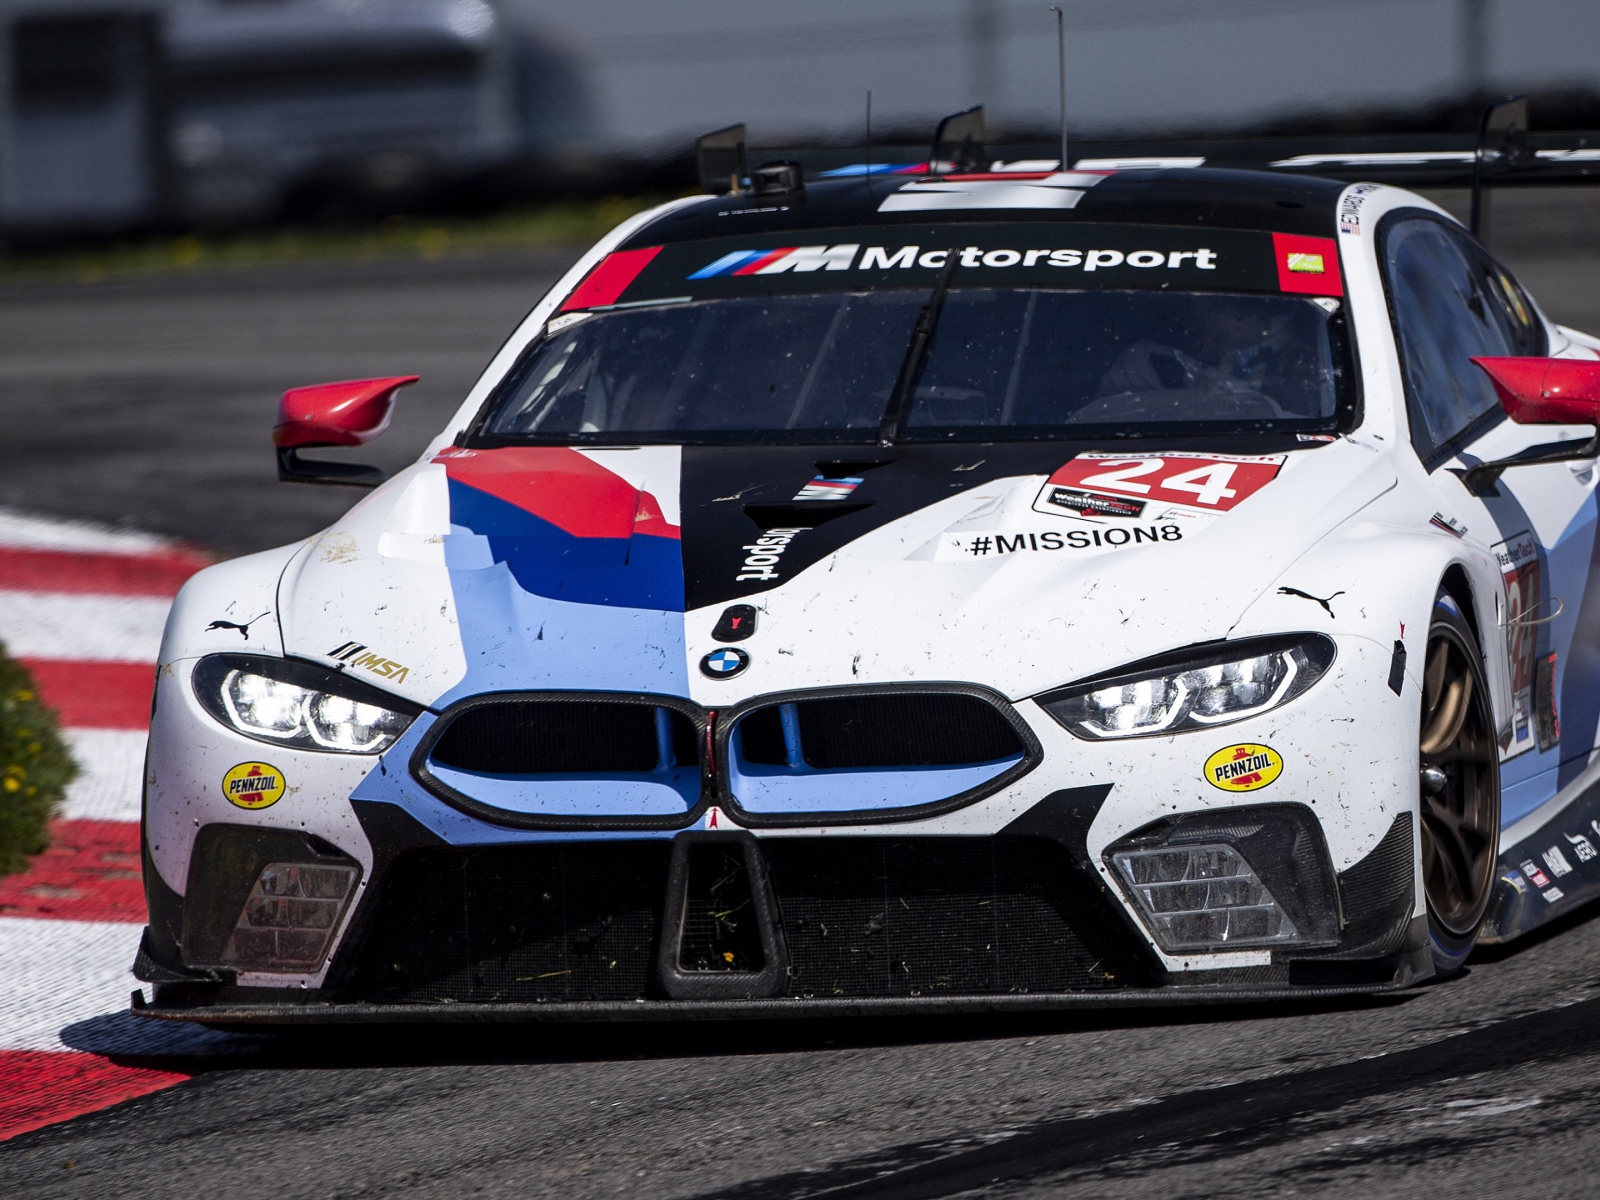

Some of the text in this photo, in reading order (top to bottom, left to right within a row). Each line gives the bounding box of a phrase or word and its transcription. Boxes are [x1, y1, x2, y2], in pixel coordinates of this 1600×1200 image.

[858, 245, 1217, 271] Motorsport
[1079, 458, 1238, 505] 24
[735, 527, 813, 582] orsport
[970, 525, 1183, 556] #MISSION8
[353, 651, 411, 684] IMSA
